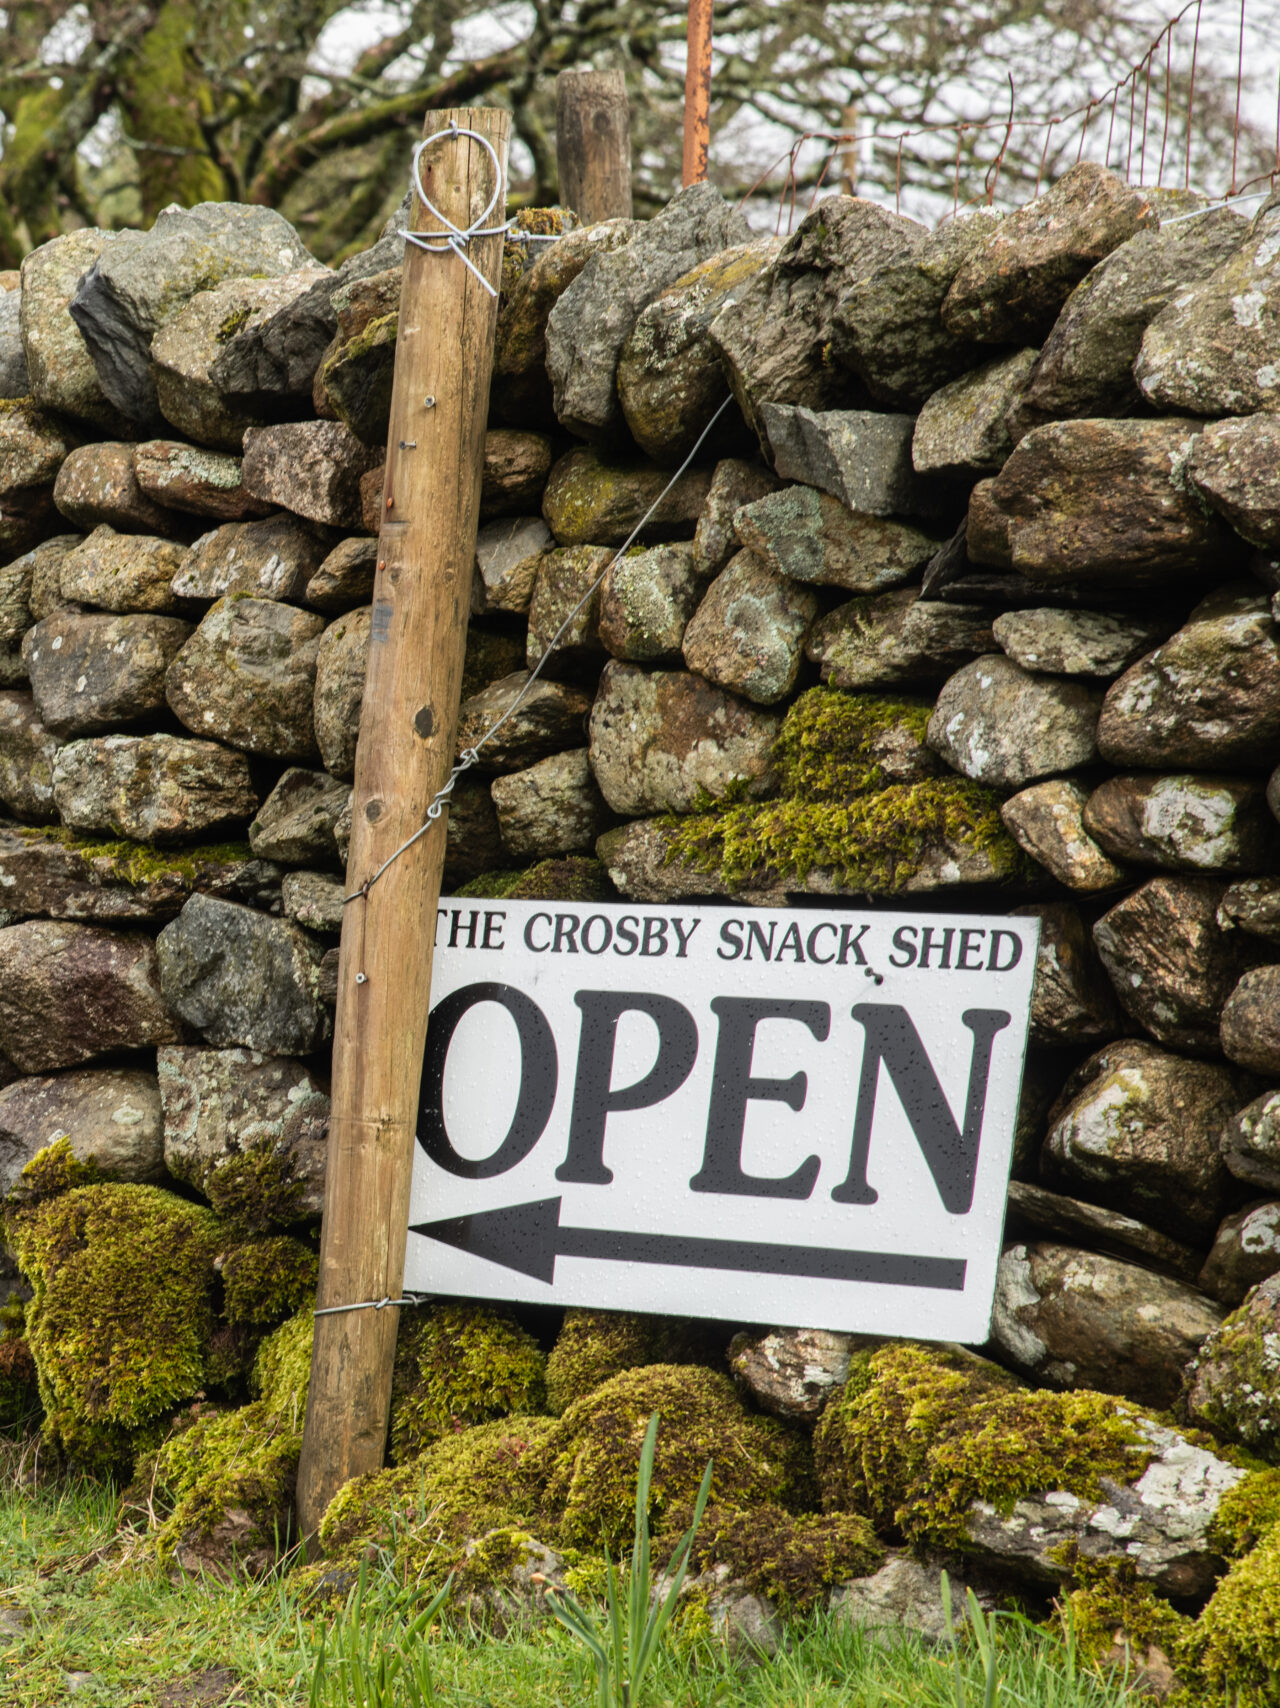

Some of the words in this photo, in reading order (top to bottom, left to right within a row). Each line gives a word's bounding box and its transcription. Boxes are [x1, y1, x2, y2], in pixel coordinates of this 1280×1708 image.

[523, 912, 702, 958] CROSBY
[716, 919, 870, 966] SNACK
[889, 926, 1023, 972] SHED
[415, 981, 1012, 1215] OPEN
